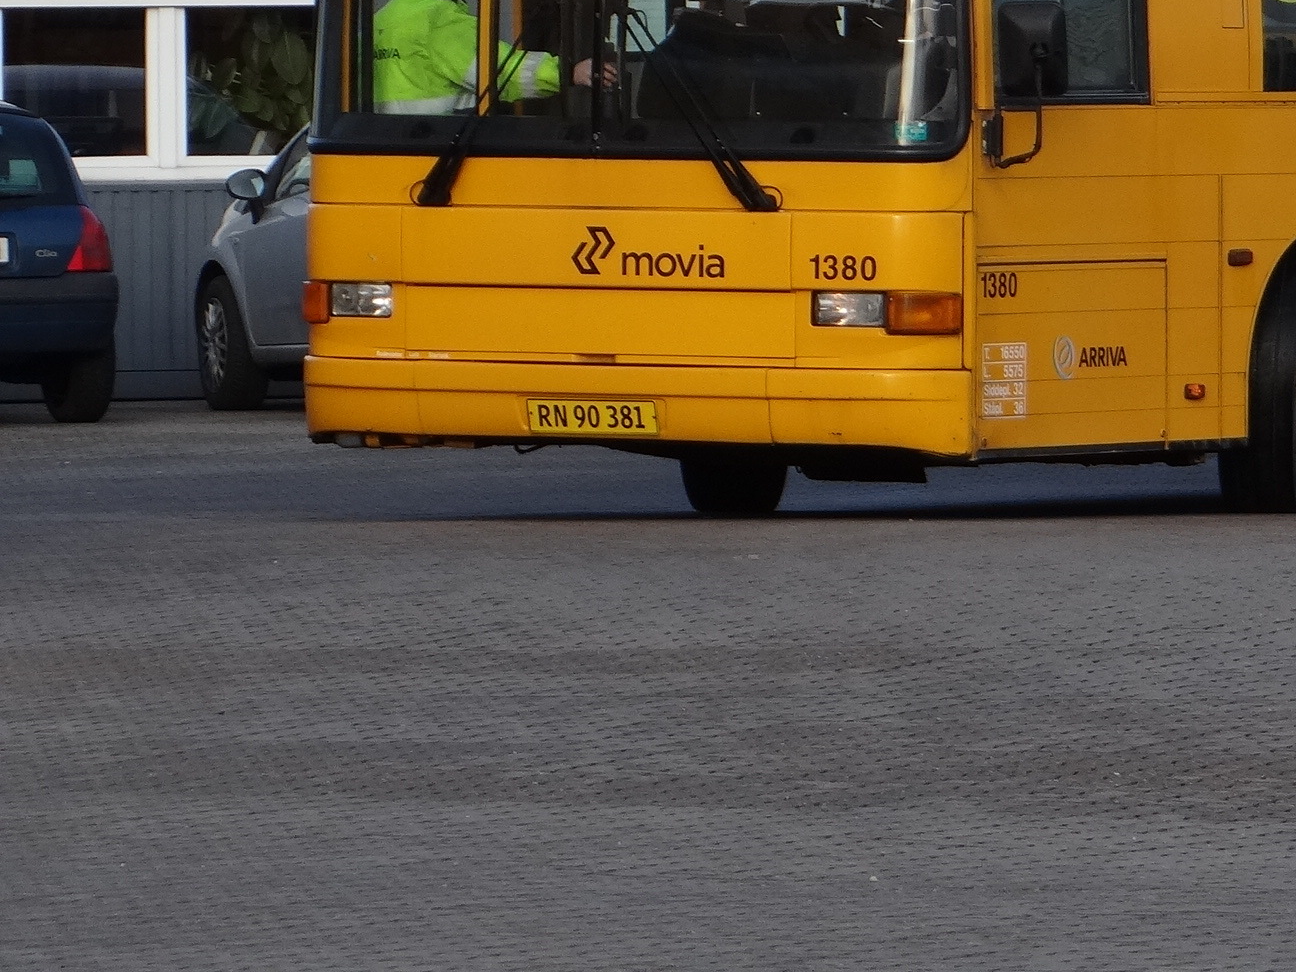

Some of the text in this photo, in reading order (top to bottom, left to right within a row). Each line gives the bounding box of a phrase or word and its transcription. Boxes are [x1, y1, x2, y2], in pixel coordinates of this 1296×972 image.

[621, 244, 726, 278] movia
[808, 253, 878, 281] 1380
[980, 272, 1018, 299] 1380
[1000, 345, 1025, 359] 16550
[1078, 346, 1128, 368] ARRIVA
[1003, 364, 1024, 378] 5575
[1012, 382, 1024, 396] 32
[536, 403, 646, 429] RN 90 381
